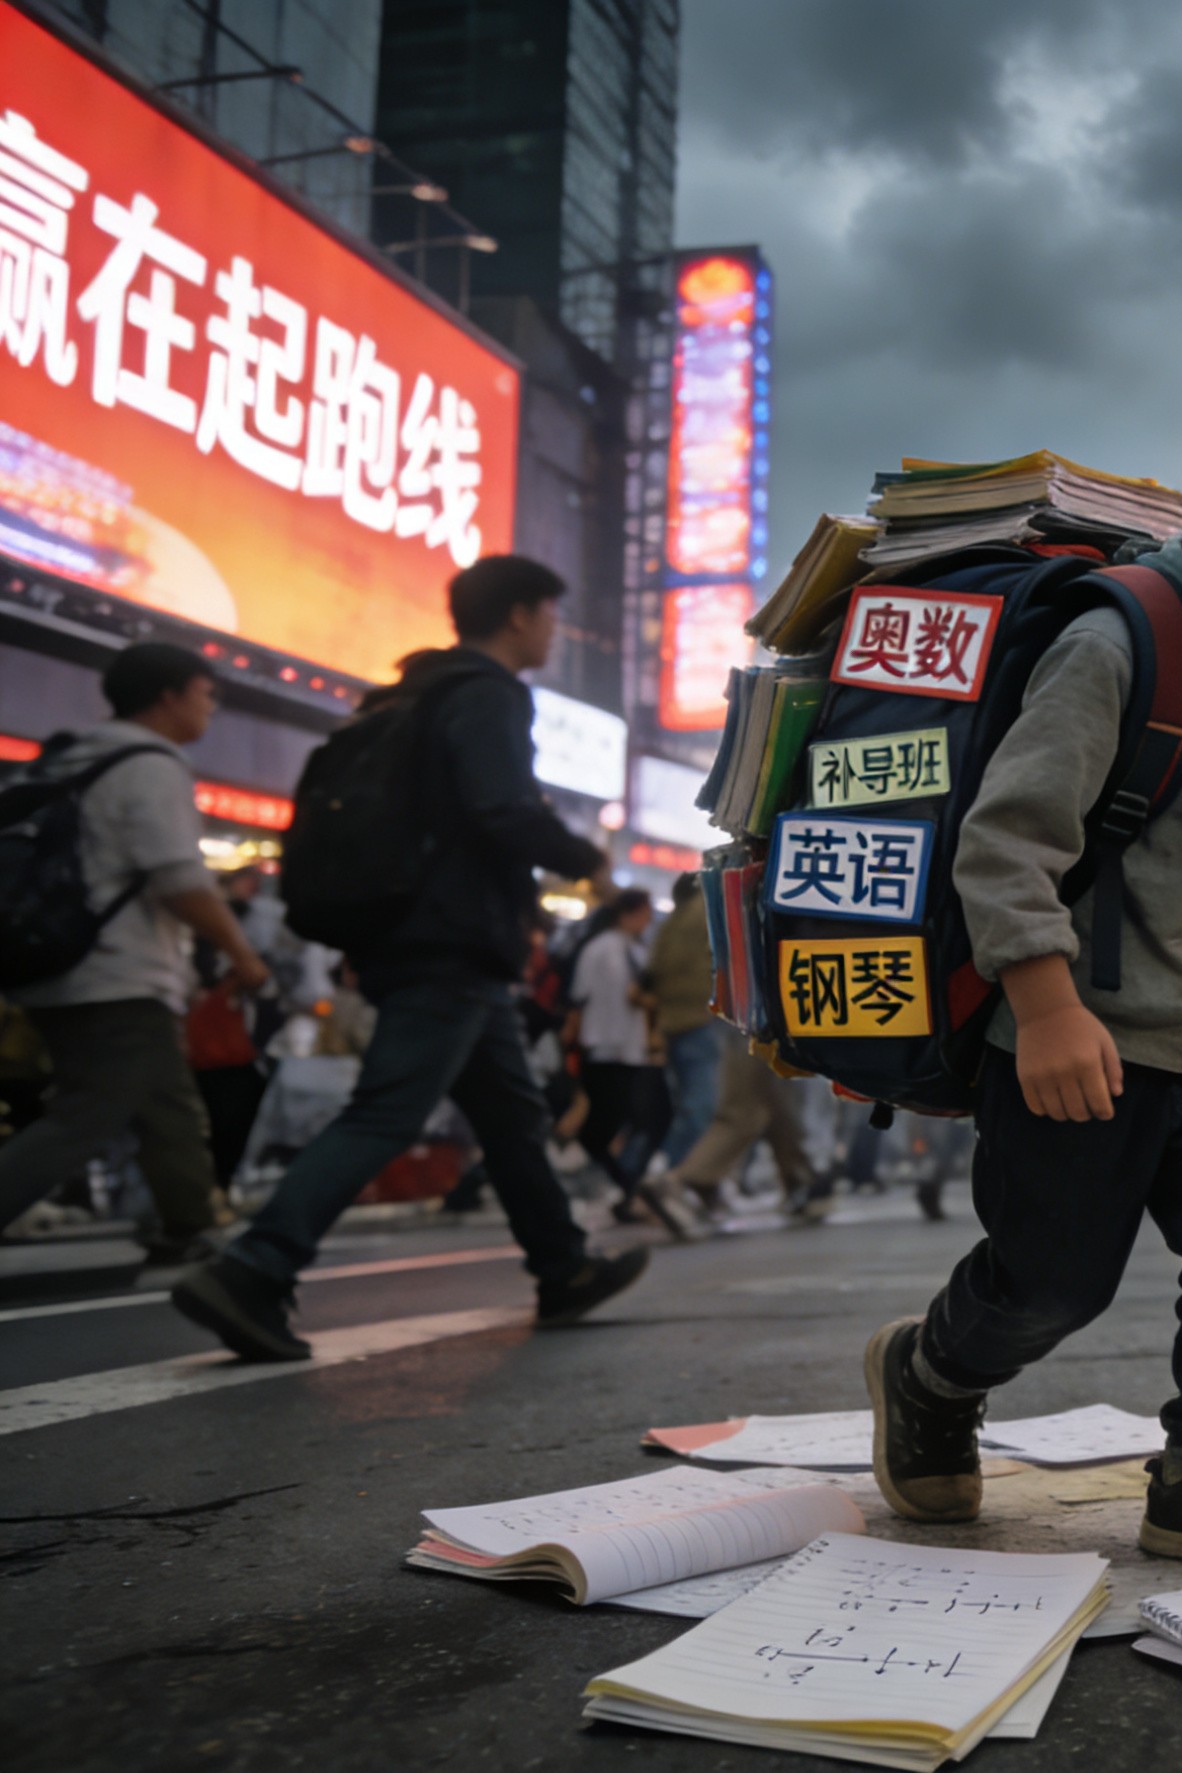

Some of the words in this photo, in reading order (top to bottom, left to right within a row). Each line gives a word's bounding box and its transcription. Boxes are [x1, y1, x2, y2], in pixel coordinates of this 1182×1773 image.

[847, 602, 979, 685] 奥数
[780, 828, 915, 910] 英语
[789, 949, 915, 1026] 钢琴
